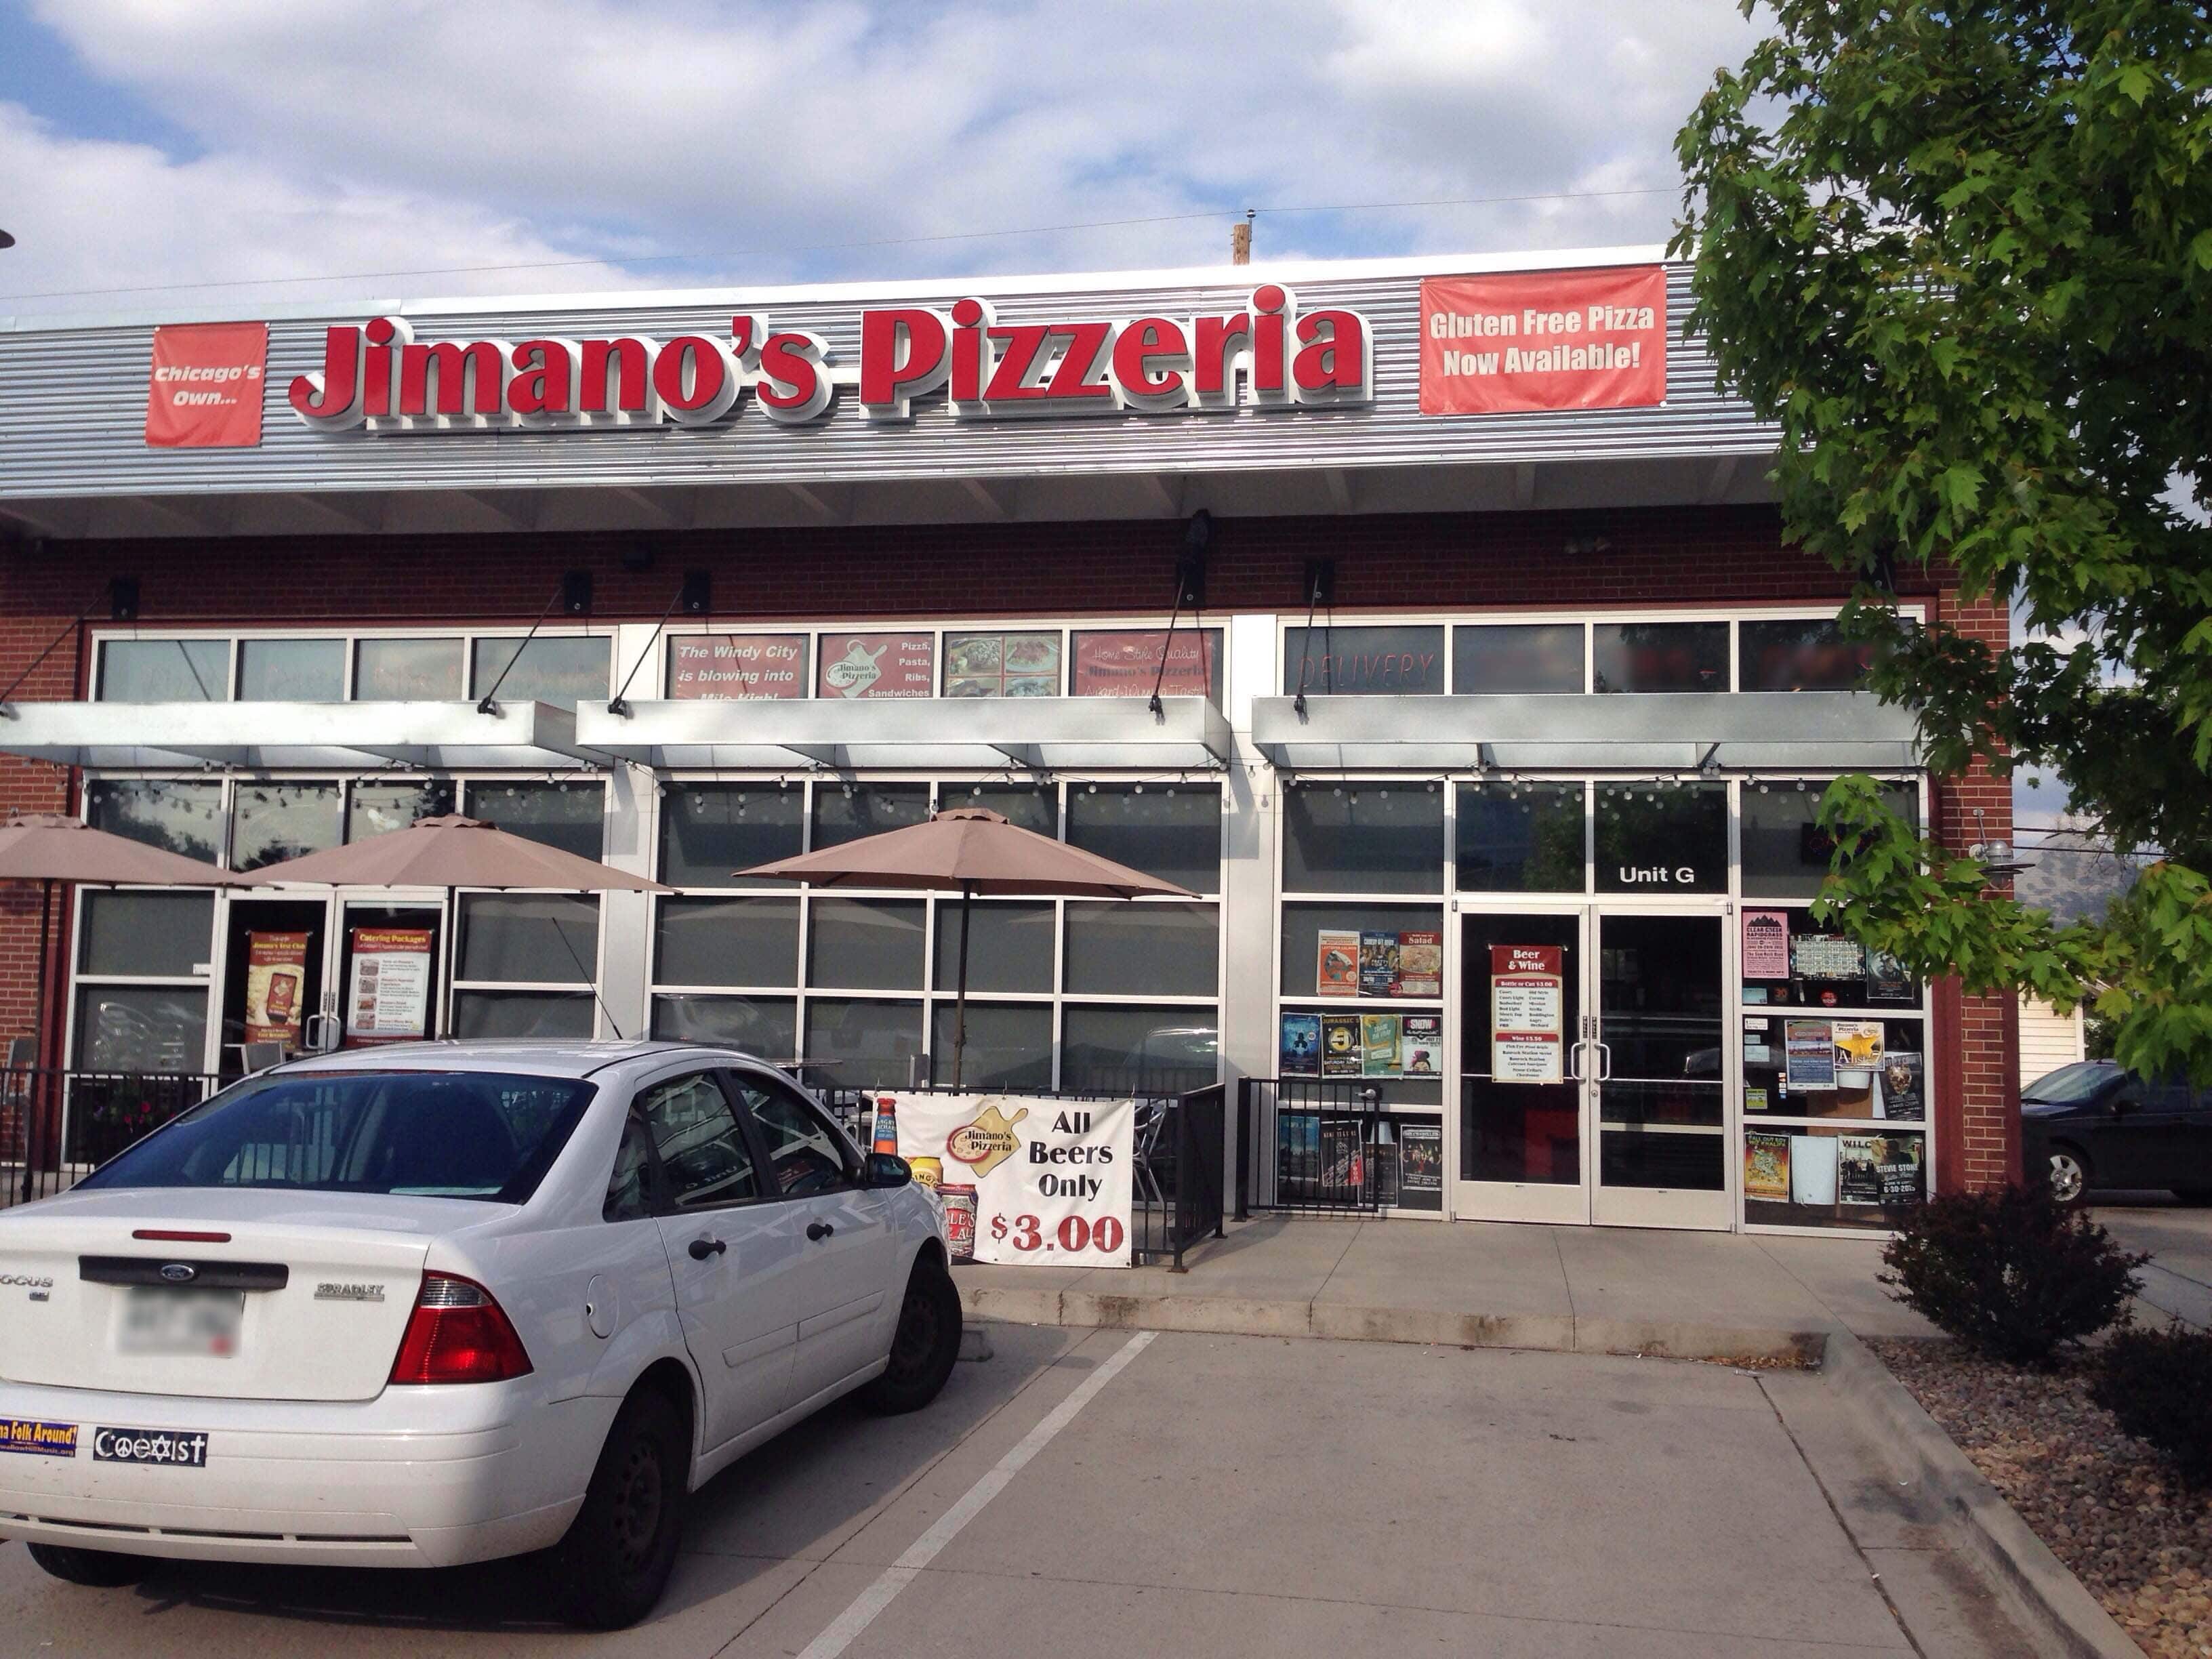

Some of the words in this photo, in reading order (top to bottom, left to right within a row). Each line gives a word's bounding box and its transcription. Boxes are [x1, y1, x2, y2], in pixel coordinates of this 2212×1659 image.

[1429, 312, 1517, 340] Gluten
[1523, 308, 1582, 335] Free
[1587, 305, 1655, 332] Pizza
[289, 316, 820, 420] Jimano's
[859, 284, 1364, 406] Pizzeria
[1443, 350, 1499, 377] Now
[1504, 342, 1641, 374] Available!
[154, 365, 262, 383] Chicago's
[172, 390, 238, 406] Own...
[680, 646, 709, 658] The
[714, 646, 760, 661] Windy
[765, 646, 798, 661] City
[1092, 647, 1120, 660] Home
[1124, 647, 1152, 662] Style
[1155, 646, 1200, 661] Quality
[838, 663, 877, 672] Jimano's
[898, 657, 930, 667] Pasta,
[679, 670, 693, 682] is
[697, 670, 760, 685] blowing
[764, 670, 794, 682] into
[842, 672, 877, 680] Pizzeria
[904, 673, 930, 682] Ribs,
[1298, 653, 1435, 688] DELIVERY
[867, 689, 930, 697] Sandwiches
[1619, 866, 1668, 883] Unit
[1675, 867, 1694, 883] G
[359, 933, 391, 943] Catering
[391, 934, 426, 944] Packages
[1513, 949, 1540, 959] Beer
[1508, 960, 1517, 970] &
[1517, 960, 1546, 970] Wine
[1051, 1111, 1090, 1134] All
[964, 1130, 1012, 1141] Jimano's
[970, 1141, 1012, 1152] Pizzeria
[1843, 1140, 1871, 1149] WILC
[1029, 1141, 1113, 1164] Beers
[1876, 1164, 1898, 1173] STEVIE
[1038, 1173, 1103, 1202] Only
[949, 1212, 976, 1227] LE'S
[991, 1212, 1124, 1253] $3.00
[0, 1274, 54, 1288] OCUS
[11, 1420, 33, 1441] Folk
[33, 1423, 78, 1445] Around?
